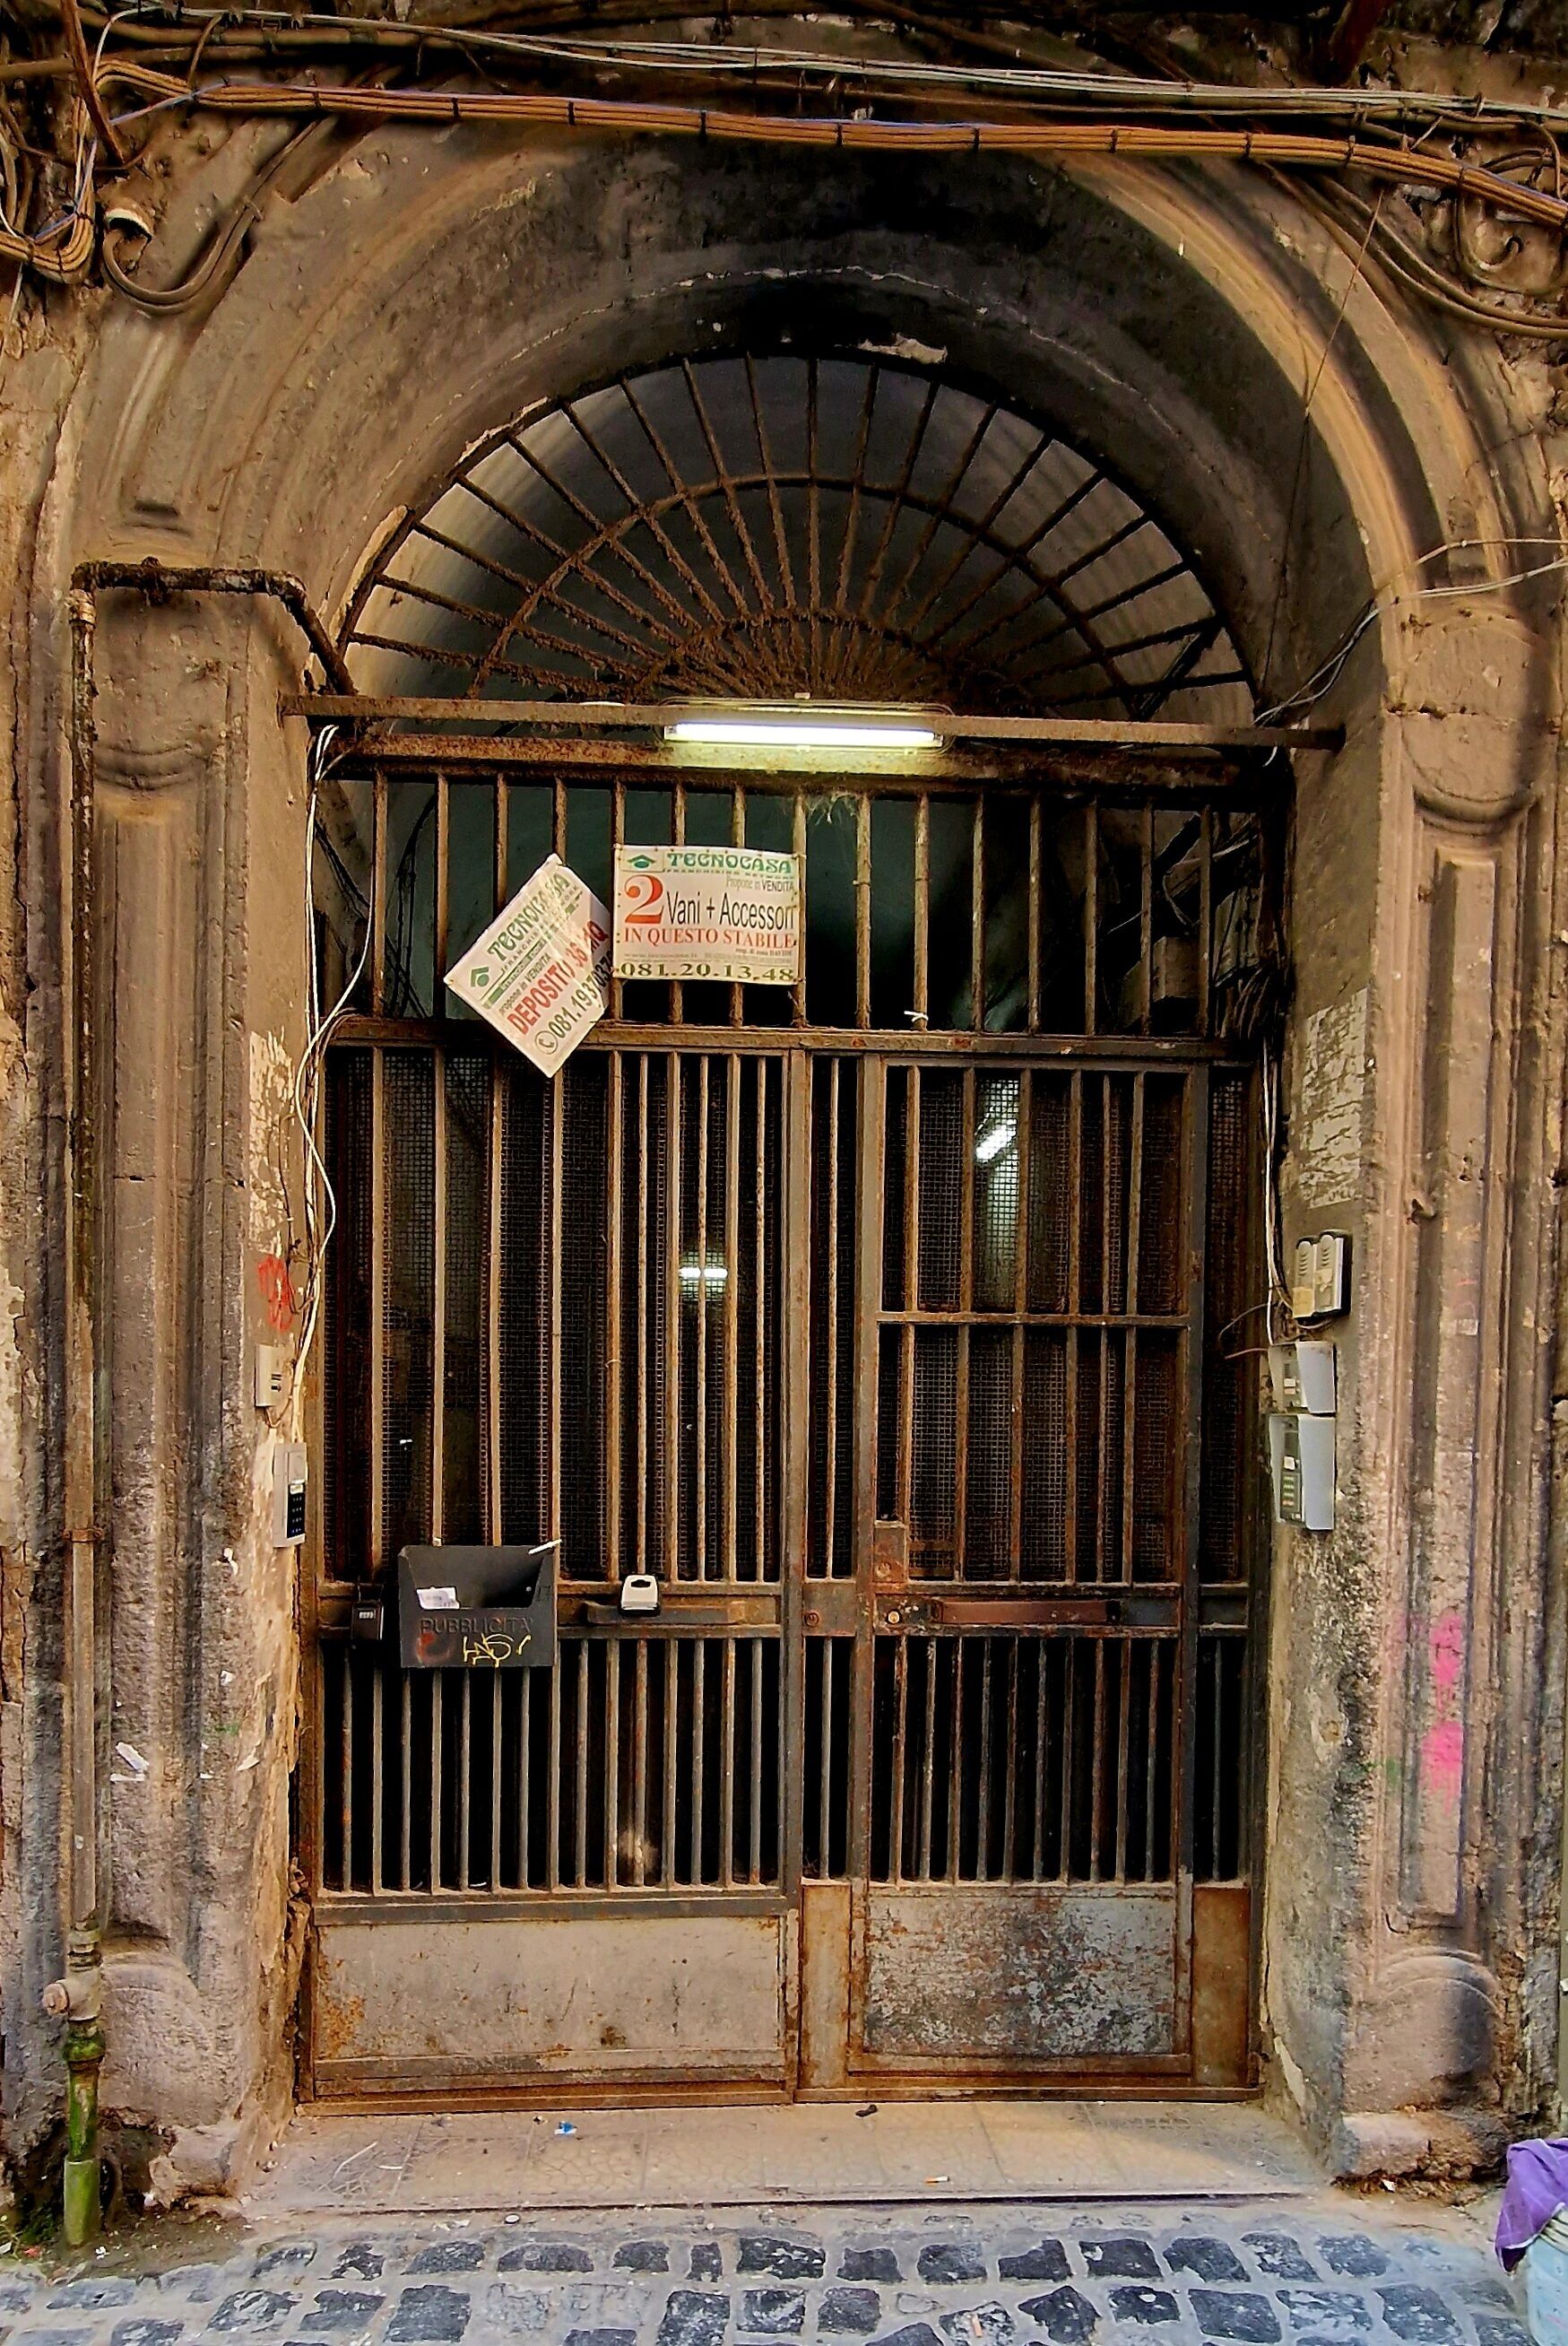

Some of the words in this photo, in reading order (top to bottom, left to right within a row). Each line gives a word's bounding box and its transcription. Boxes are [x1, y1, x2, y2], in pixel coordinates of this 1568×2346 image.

[667, 853, 792, 873] TECNOCASA
[762, 880, 793, 891] VENDITA
[625, 874, 664, 924] 2
[667, 891, 701, 925] Vani
[706, 897, 715, 919] +
[719, 892, 797, 930] Accessori
[625, 928, 643, 943] IN
[647, 928, 717, 947] QUESTO
[723, 932, 794, 949] STABILE
[525, 952, 552, 985] VENDITA
[507, 958, 576, 1035] DEPOSITO
